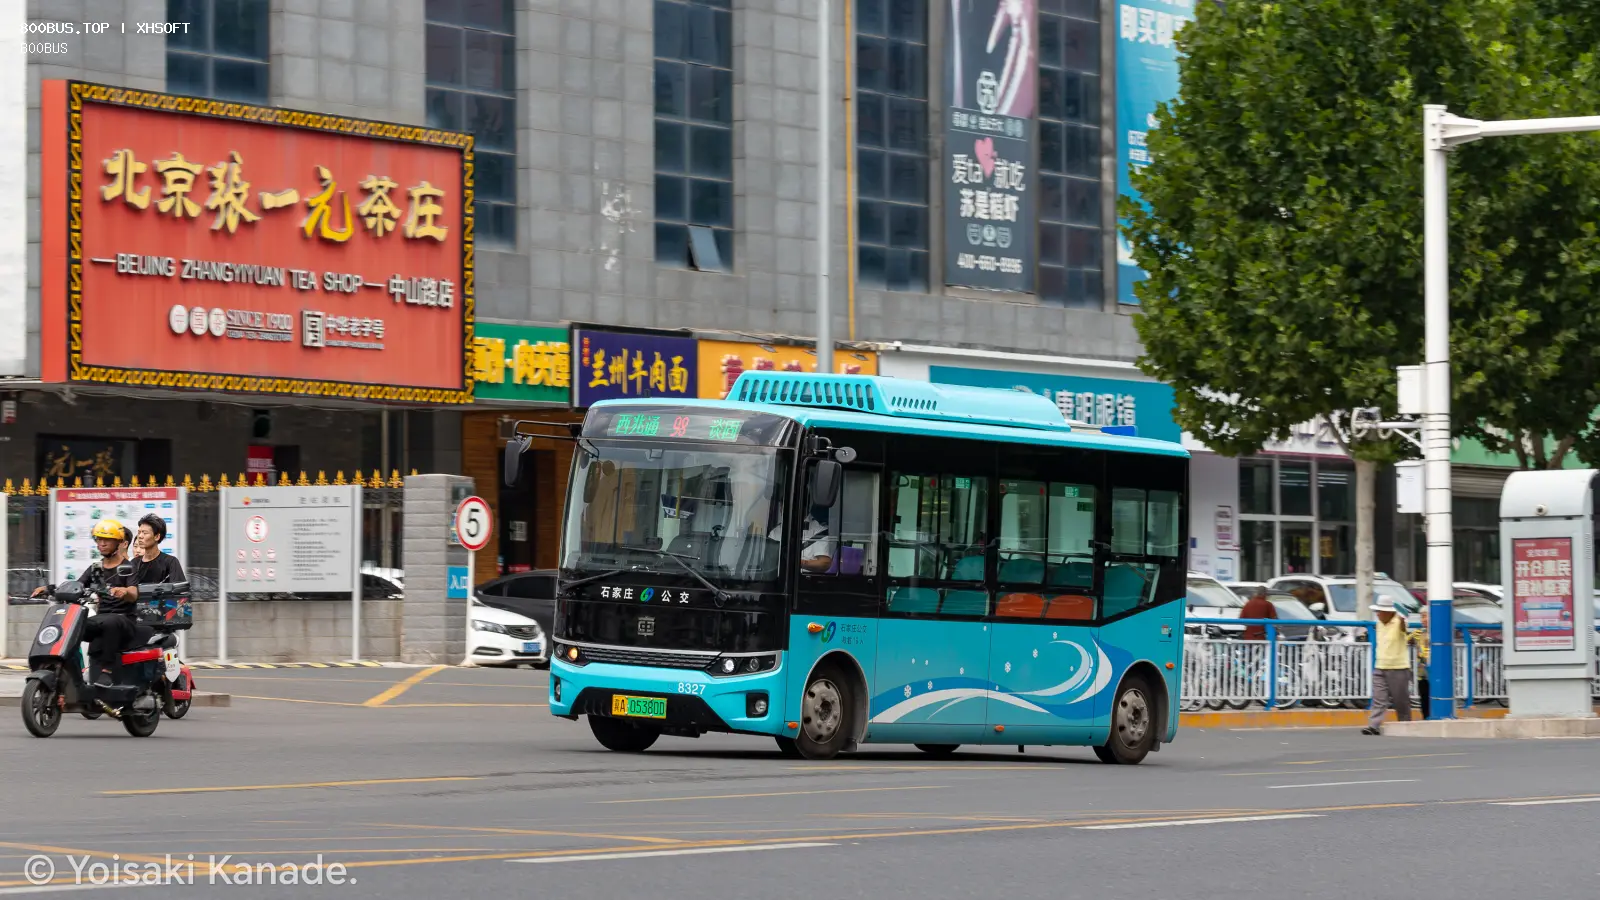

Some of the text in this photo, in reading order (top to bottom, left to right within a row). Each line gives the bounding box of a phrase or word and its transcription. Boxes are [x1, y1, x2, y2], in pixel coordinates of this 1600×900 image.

[180, 258, 285, 288] ZHANGYIYUAN
[288, 268, 318, 291] TEA
[323, 271, 364, 293] SHOP
[389, 273, 454, 309] 中山路店
[227, 308, 264, 327] SINCE
[265, 312, 294, 331] 1900
[325, 313, 385, 339] 中华老字号
[588, 347, 689, 395] 兰州牛肉面
[616, 413, 740, 440] 西兆通 98 谈固
[465, 507, 481, 538] 5
[450, 573, 469, 590] 入口
[600, 585, 690, 604] 石家庄 公交
[677, 682, 706, 695] 8327
